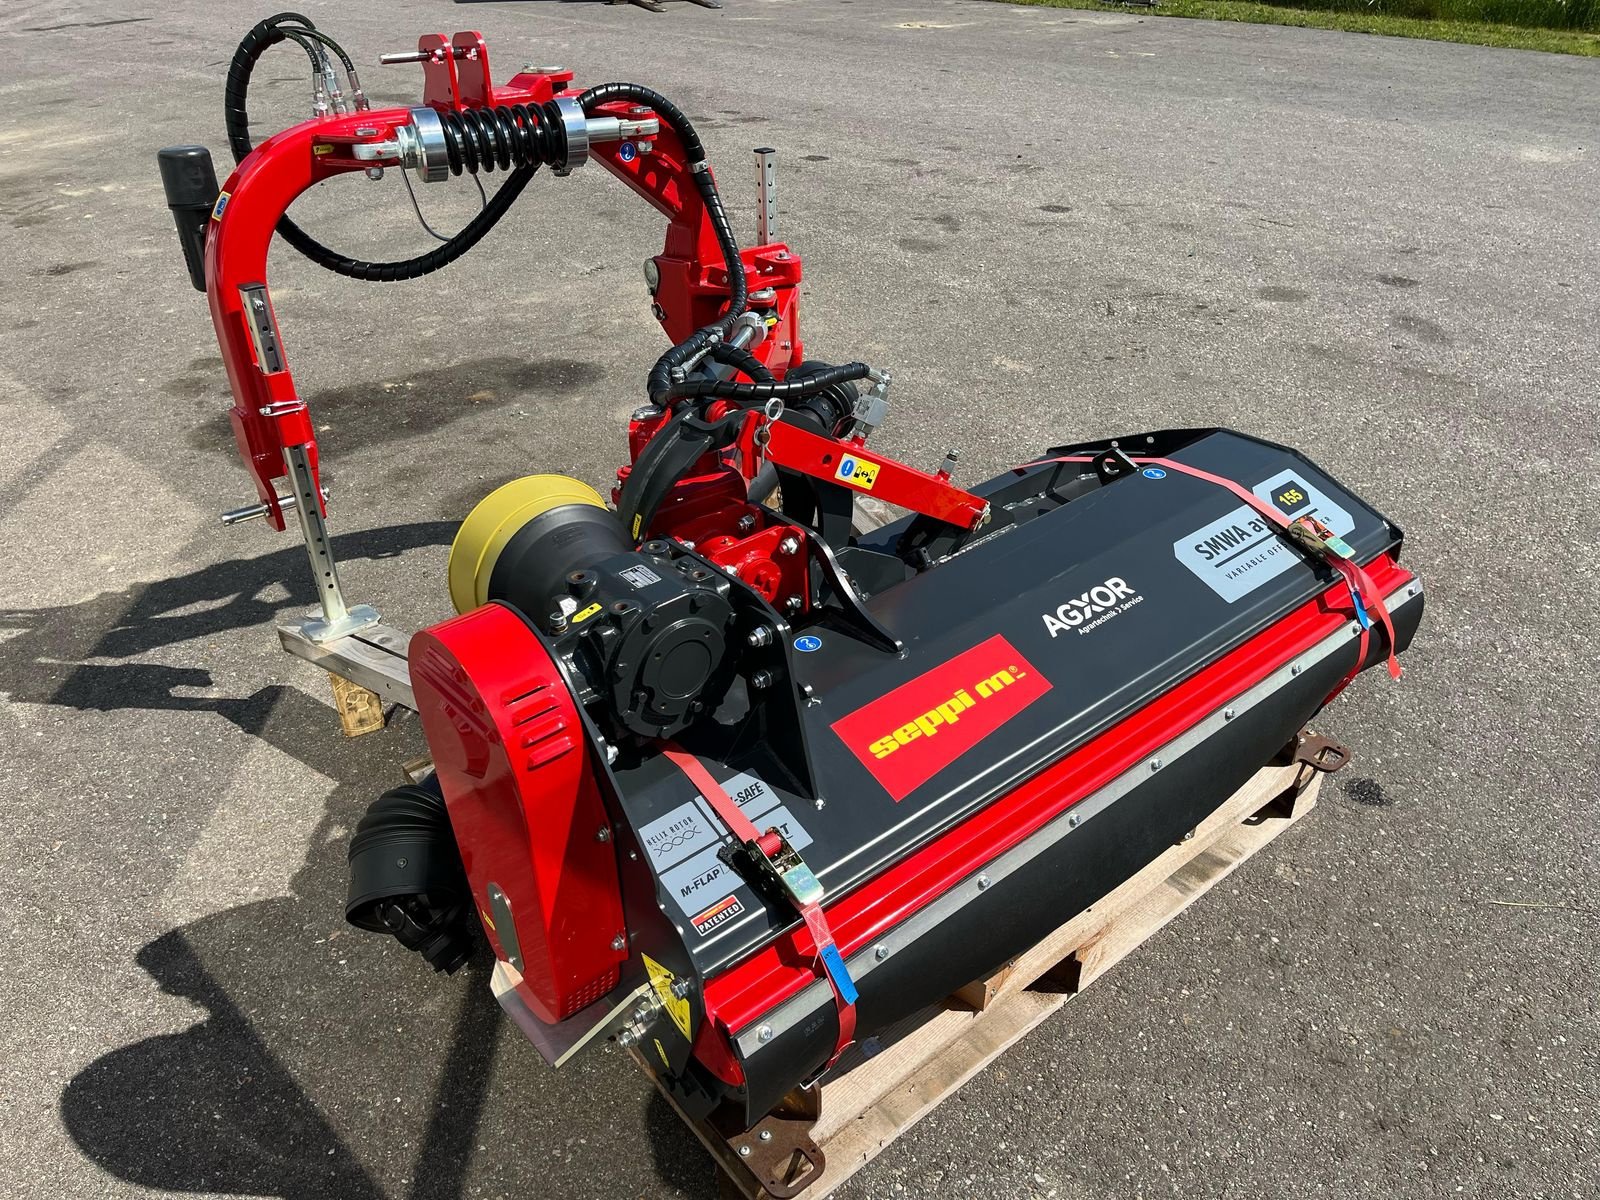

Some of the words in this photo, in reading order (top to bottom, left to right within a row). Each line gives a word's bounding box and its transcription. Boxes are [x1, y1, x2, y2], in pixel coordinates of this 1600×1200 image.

[1279, 489, 1303, 506] 155
[1194, 525, 1252, 560] SMWA
[1225, 554, 1267, 580] VARIABLE
[1267, 542, 1288, 556] OFFS
[1042, 577, 1136, 638] AGXOR
[1078, 610, 1117, 635] Agrartechnik
[1120, 595, 1144, 611] Service
[868, 688, 976, 760] seppi
[646, 830, 668, 846] HELIX
[669, 816, 694, 834] ROTOR
[680, 868, 720, 897] M-FLAP
[698, 903, 740, 933] PATENTED
